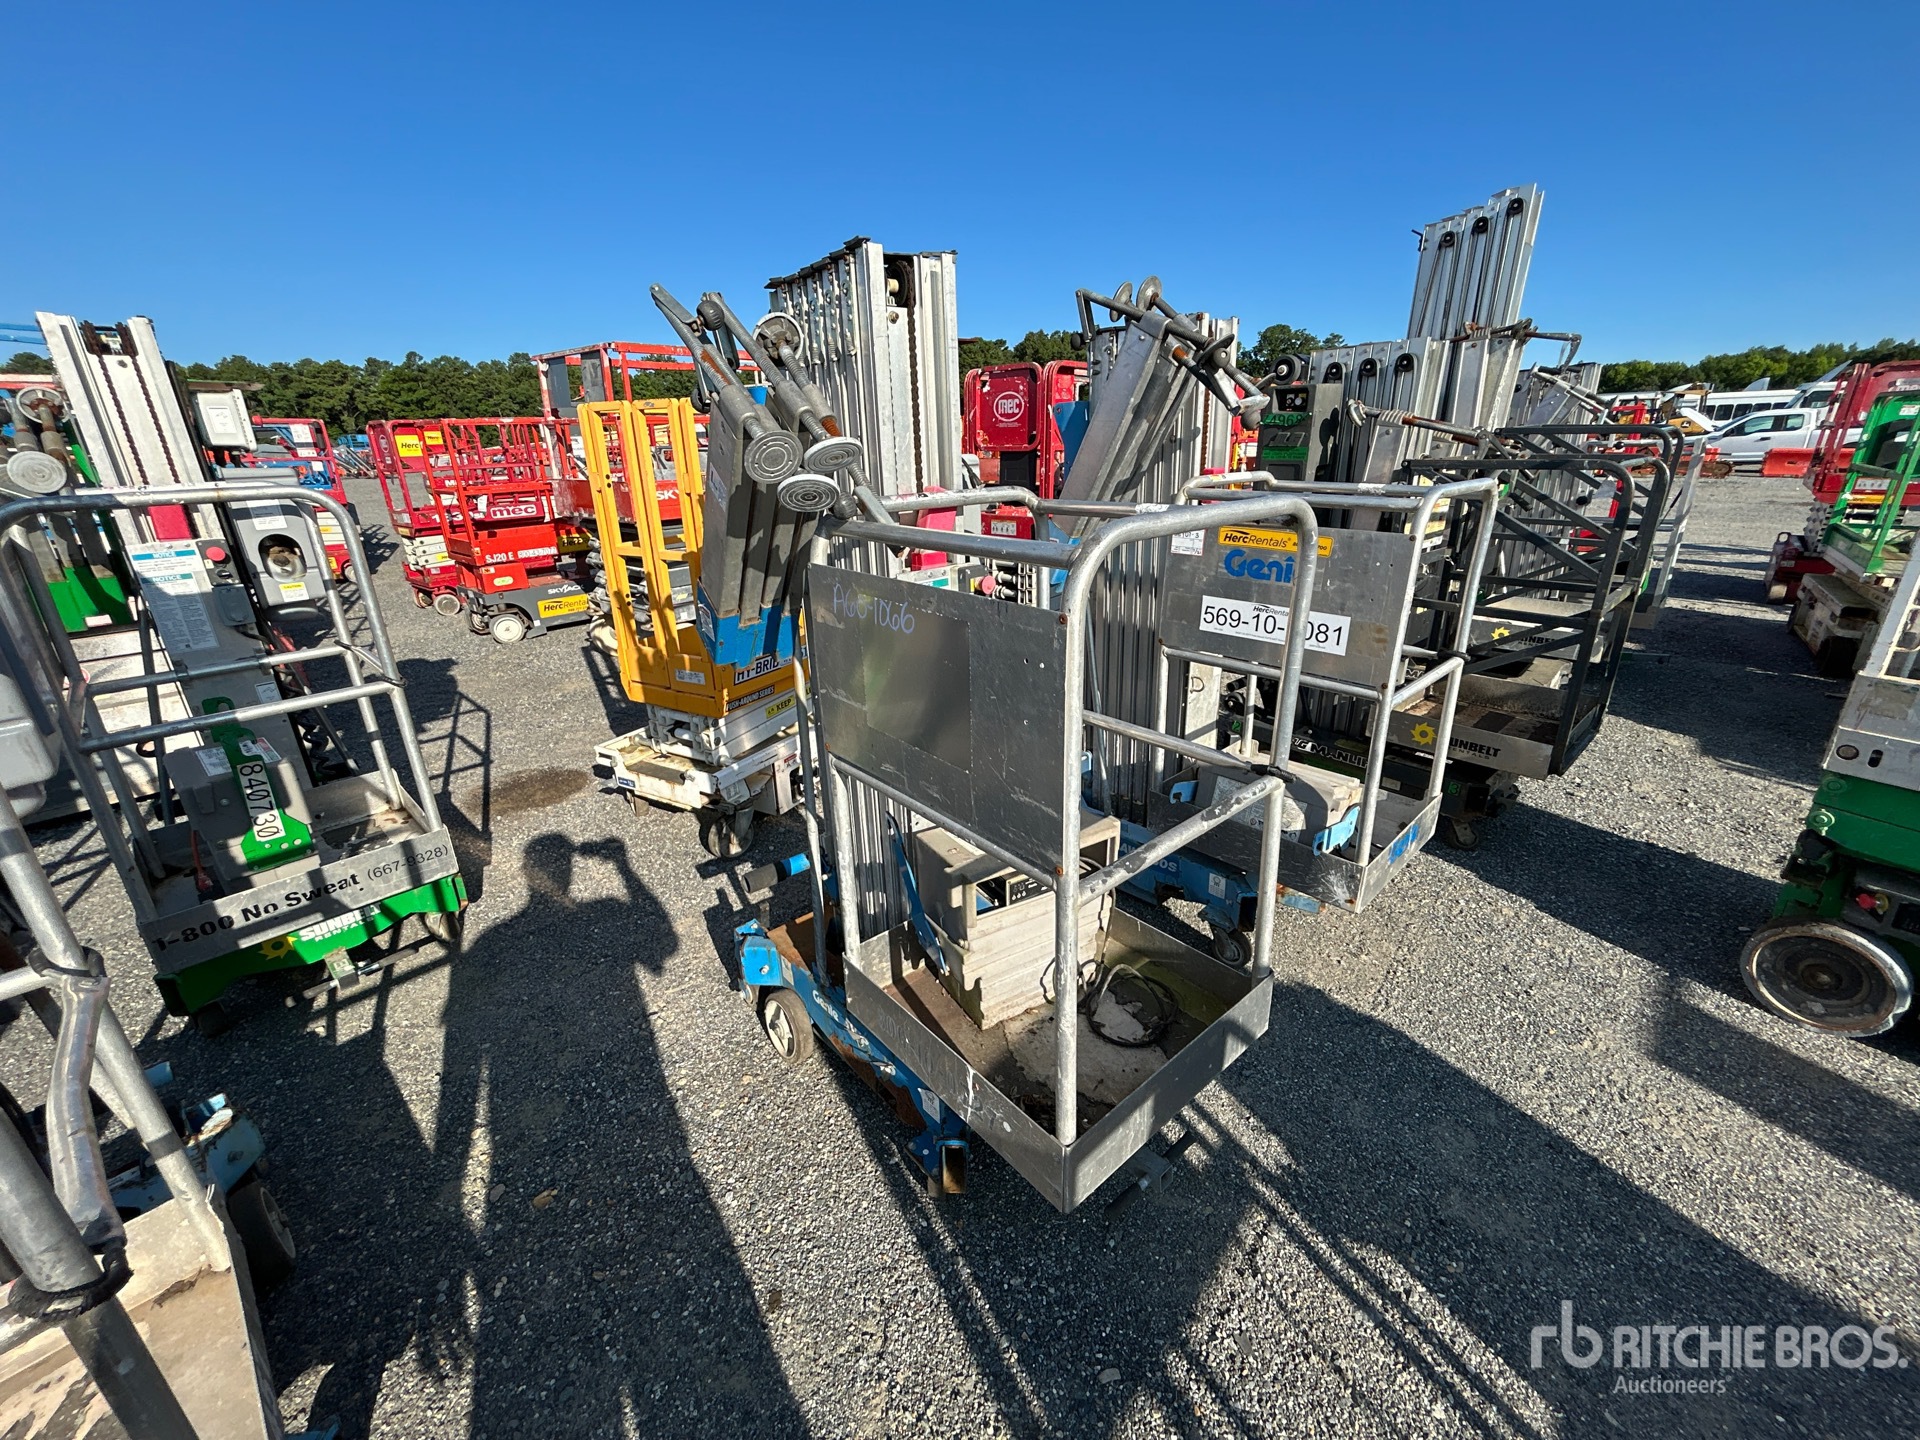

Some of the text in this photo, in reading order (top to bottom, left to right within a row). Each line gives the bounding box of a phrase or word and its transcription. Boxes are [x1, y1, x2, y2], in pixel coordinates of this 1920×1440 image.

[998, 399, 1020, 415] mec
[492, 504, 536, 518] mec
[1224, 549, 1296, 584] Geni
[153, 574, 182, 582] NOTICE
[776, 698, 792, 711] KEEP
[1449, 737, 1501, 758] UNBELT
[239, 763, 282, 838] 840730
[151, 843, 449, 951] 1-800 No Sweat (667-9328)
[812, 989, 840, 1022] Genie
